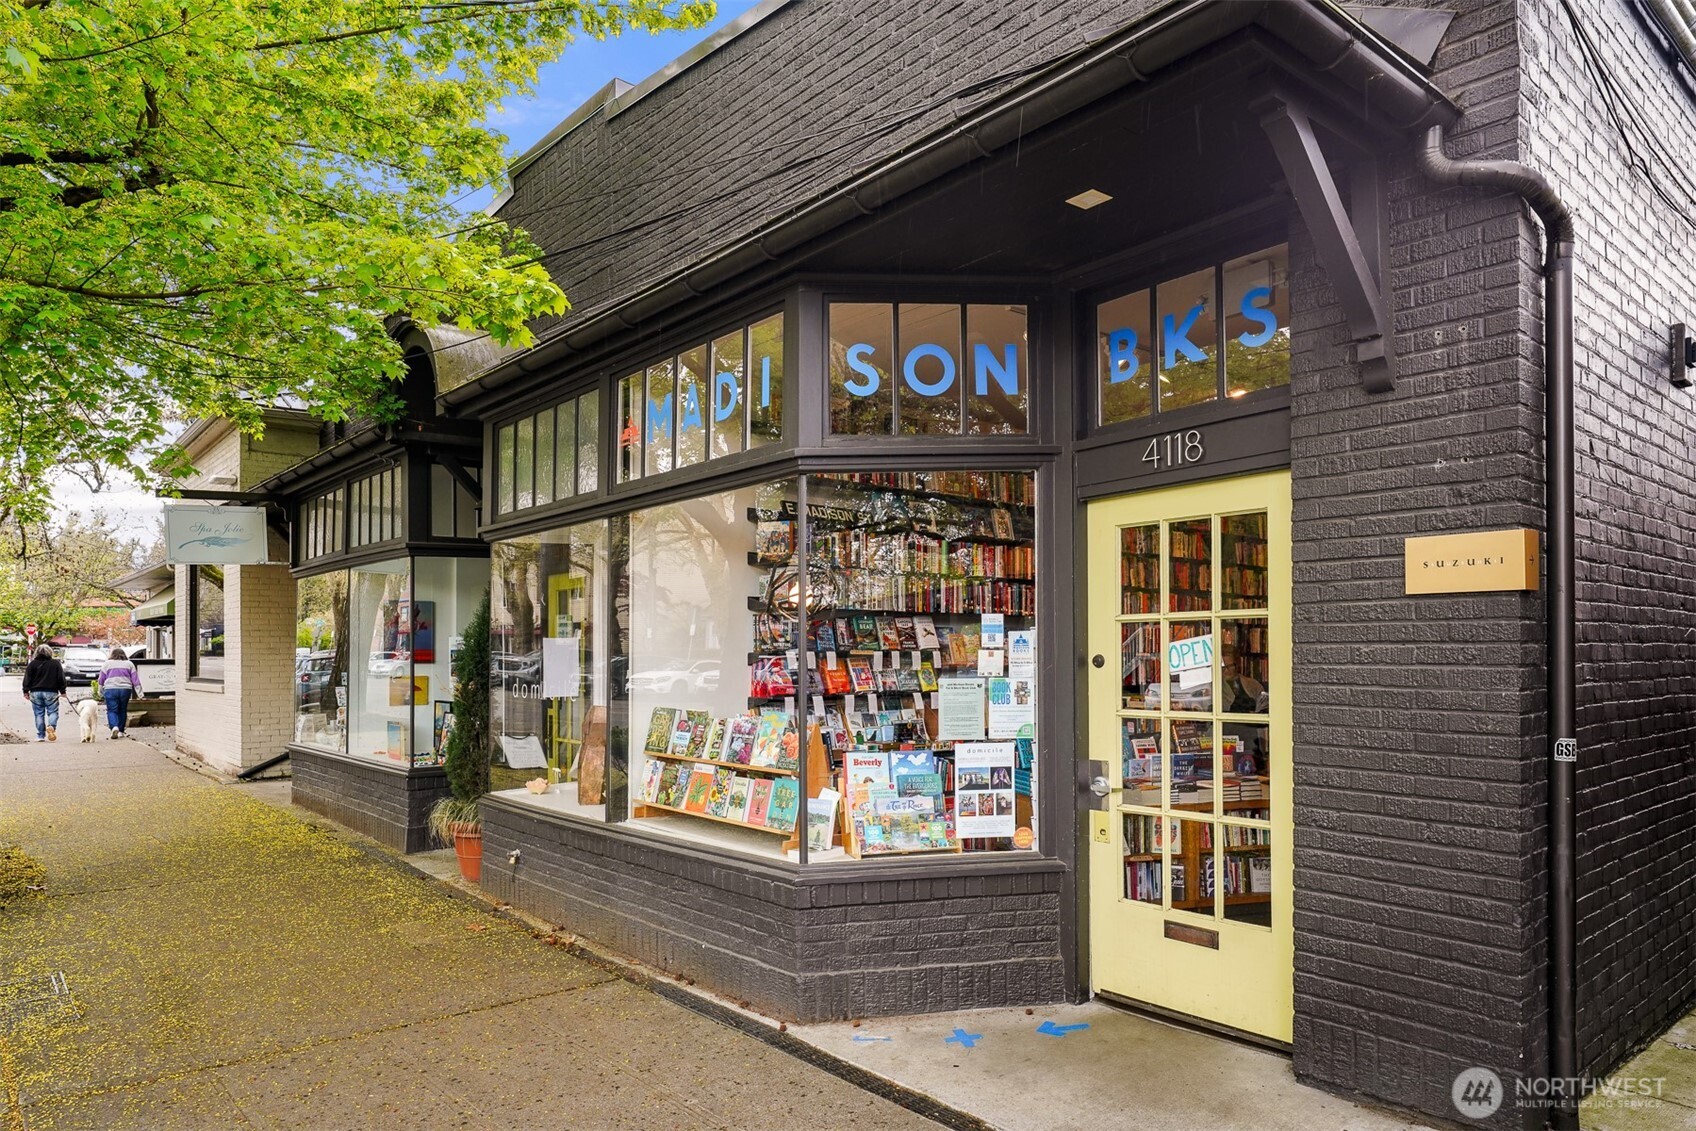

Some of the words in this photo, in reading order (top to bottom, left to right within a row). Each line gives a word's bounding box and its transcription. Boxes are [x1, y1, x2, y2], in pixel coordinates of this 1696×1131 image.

[1110, 286, 1278, 384] BKS
[1142, 430, 1203, 469] 4118
[189, 522, 213, 536] Spa
[214, 522, 244, 536] Jolie
[1423, 556, 1504, 569] SUZUKI
[1169, 638, 1213, 669] OPEN
[992, 682, 1011, 693] BOOK
[992, 693, 1011, 705] CLUB
[853, 758, 882, 768] Beverly
